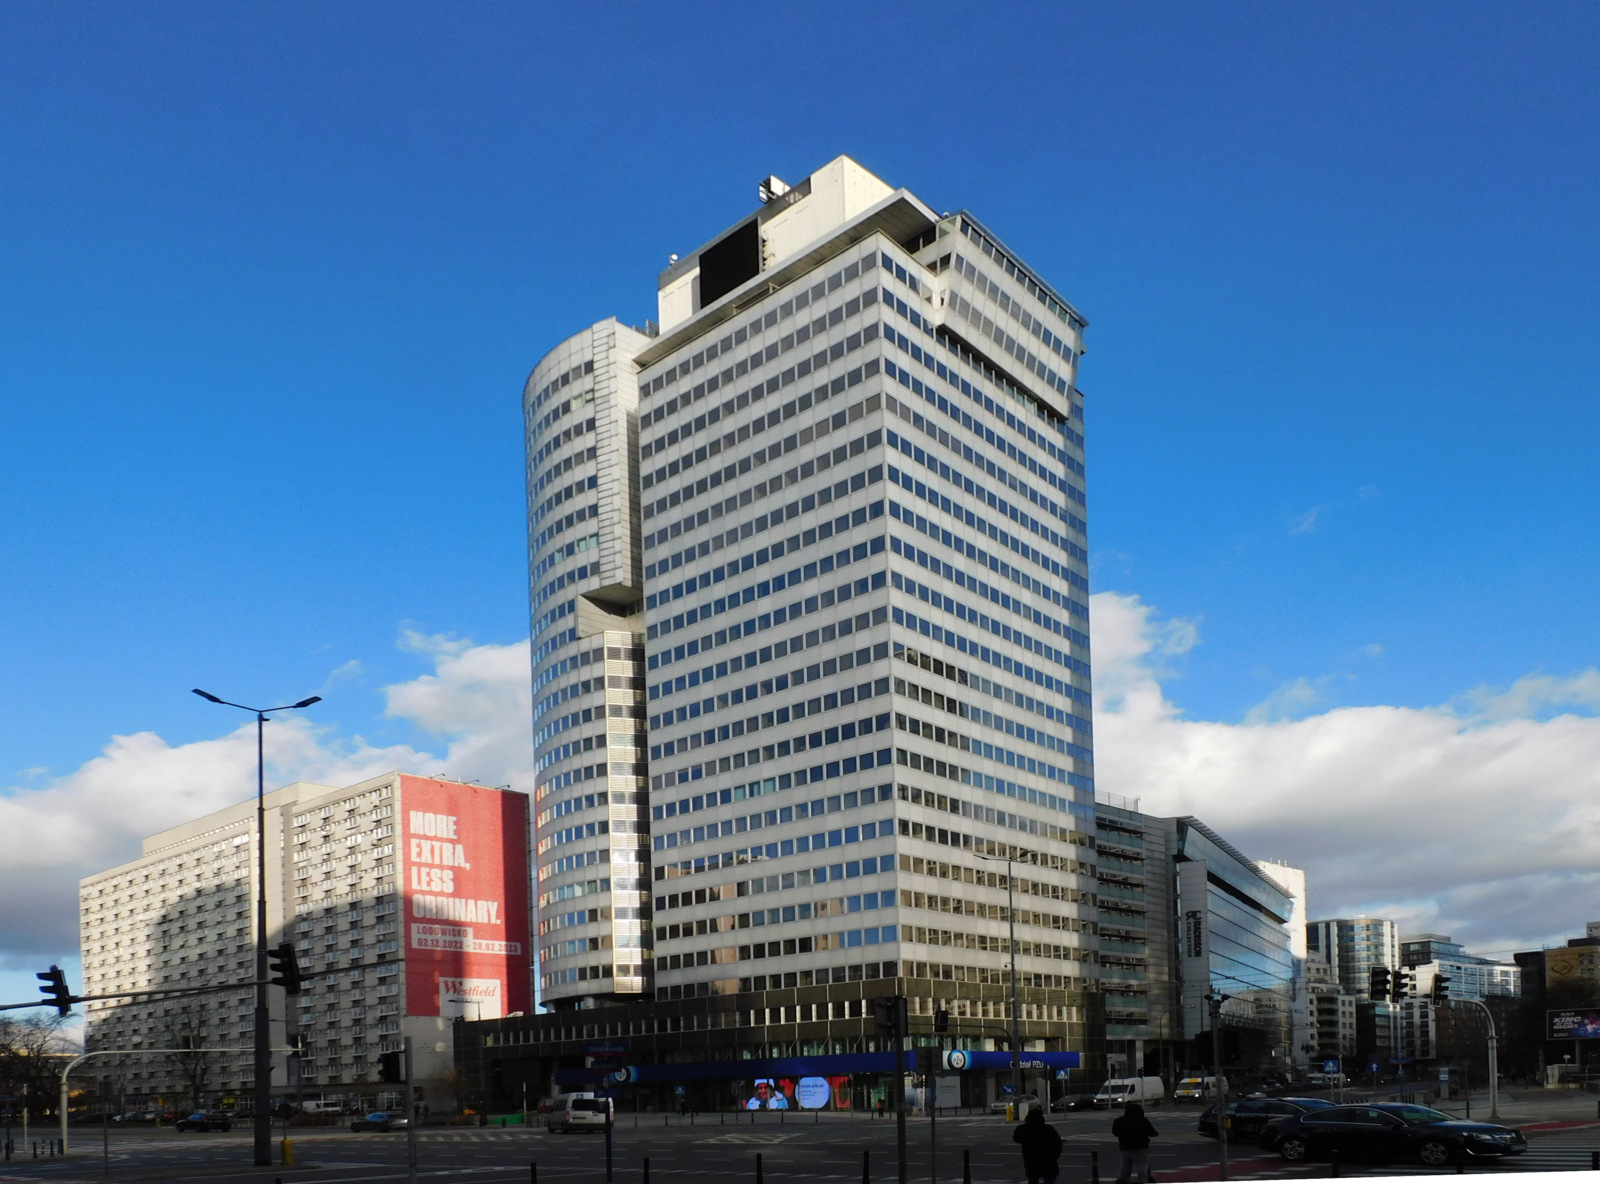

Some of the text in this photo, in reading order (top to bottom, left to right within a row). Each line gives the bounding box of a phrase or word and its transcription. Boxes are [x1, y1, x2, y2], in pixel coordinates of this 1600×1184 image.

[410, 810, 458, 839] MORE
[410, 838, 470, 870] EXTRA,
[411, 866, 454, 893] LESS
[412, 894, 501, 925] ORDINARY.
[417, 926, 468, 937] LODOWISKO
[1193, 921, 1202, 957] RADISSON
[417, 938, 464, 950] 02.12.2022
[472, 942, 518, 953] 28.02.2023
[442, 980, 497, 997] Westfield
[1010, 1060, 1043, 1068] Oział PZU
